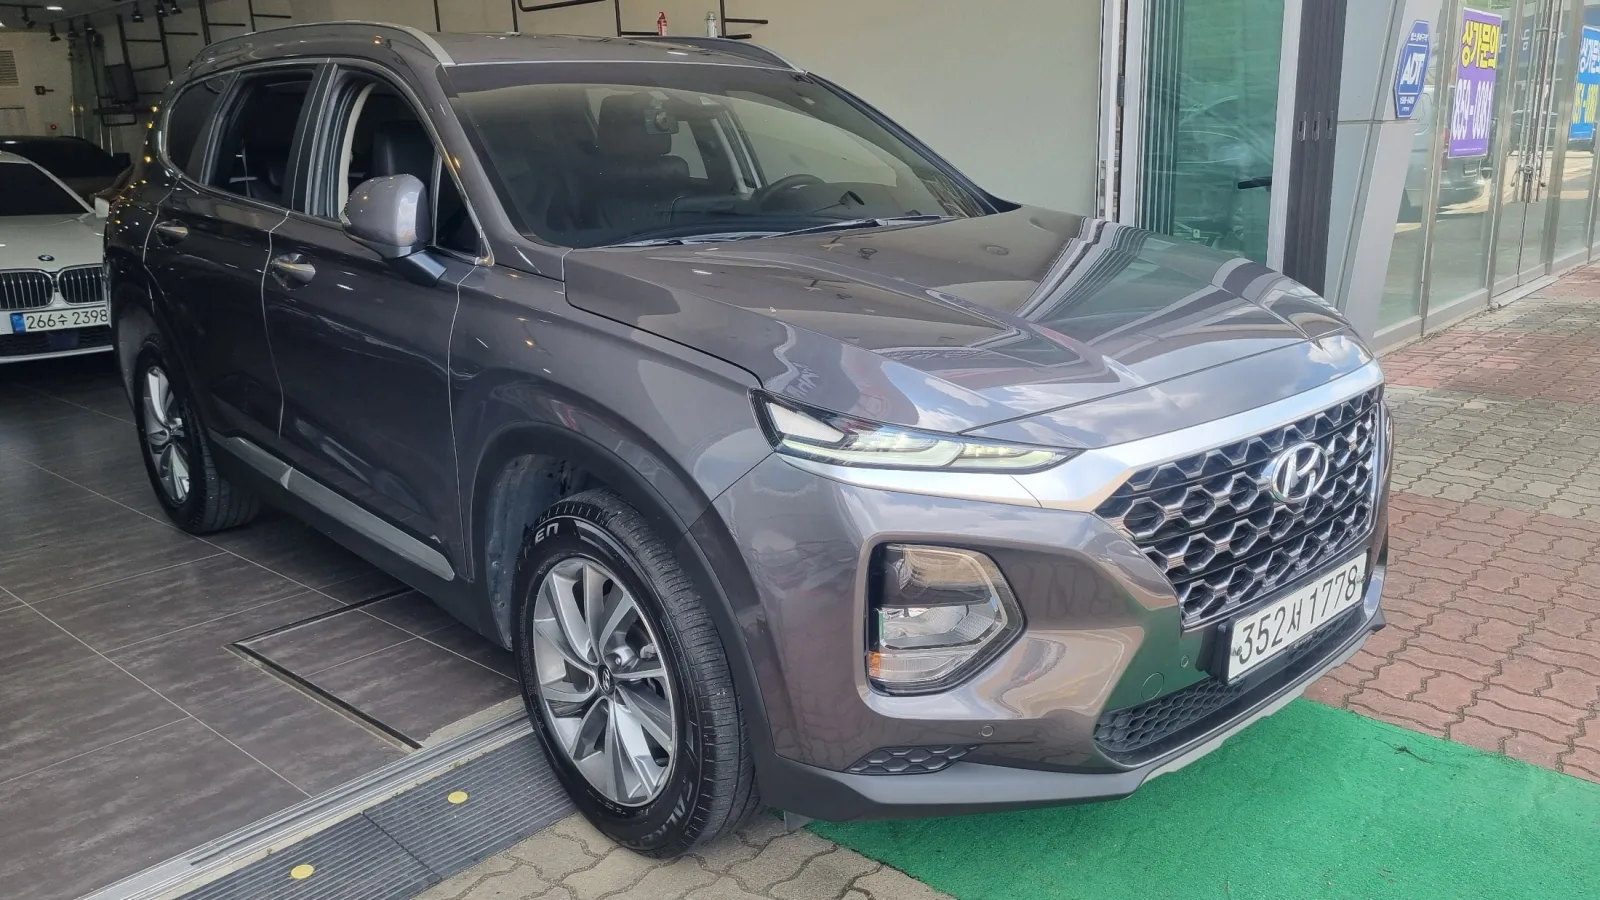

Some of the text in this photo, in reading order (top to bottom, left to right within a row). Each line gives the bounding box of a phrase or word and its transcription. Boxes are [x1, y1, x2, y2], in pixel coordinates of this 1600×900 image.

[1461, 19, 1500, 70] 상가문의
[1579, 37, 1600, 73] 상가문
[1400, 52, 1426, 85] ADT
[26, 309, 108, 330] 266수 2398
[1238, 564, 1358, 665] 352서 1778
